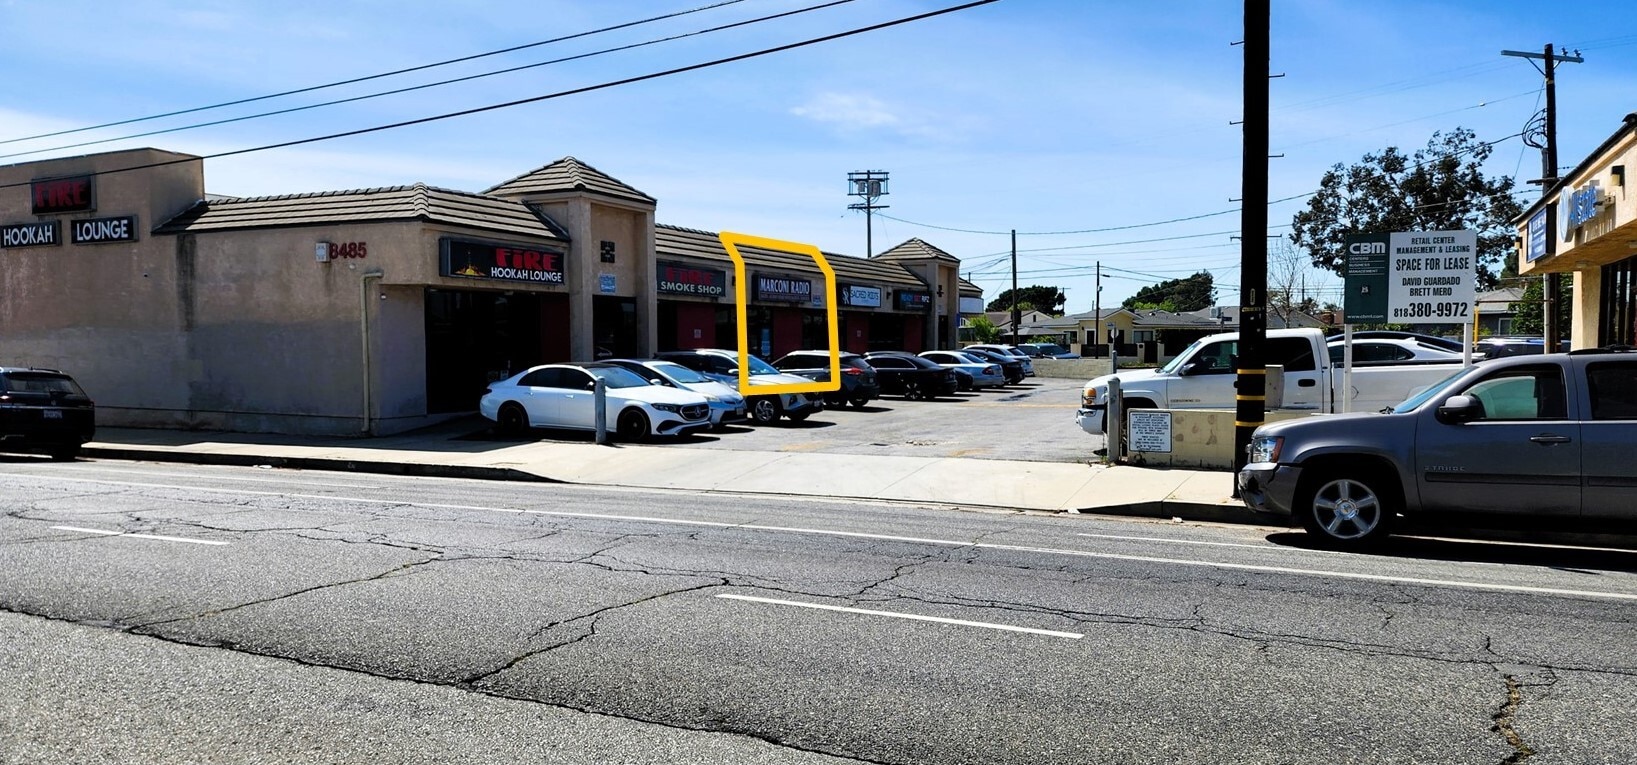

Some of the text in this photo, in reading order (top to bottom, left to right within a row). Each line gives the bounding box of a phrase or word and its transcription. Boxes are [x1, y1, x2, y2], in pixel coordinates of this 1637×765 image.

[3, 219, 128, 246] HOOKAH LOUNGE
[1411, 236, 1455, 245] RETAIL CENTER
[329, 242, 367, 259] 8485
[1349, 242, 1386, 254] CBM
[1396, 246, 1436, 254] MANAGEMENT
[1445, 245, 1470, 253] LEASING
[1396, 256, 1469, 271] SPACE FOR LEASE
[491, 267, 562, 282] HOOKAH LOUNGE
[1402, 276, 1460, 286] DAVID GUARDADO
[660, 281, 722, 294] SMOKE SHOP
[760, 278, 810, 295] MARCONI RADIO
[1409, 287, 1452, 296] BRETT MERO
